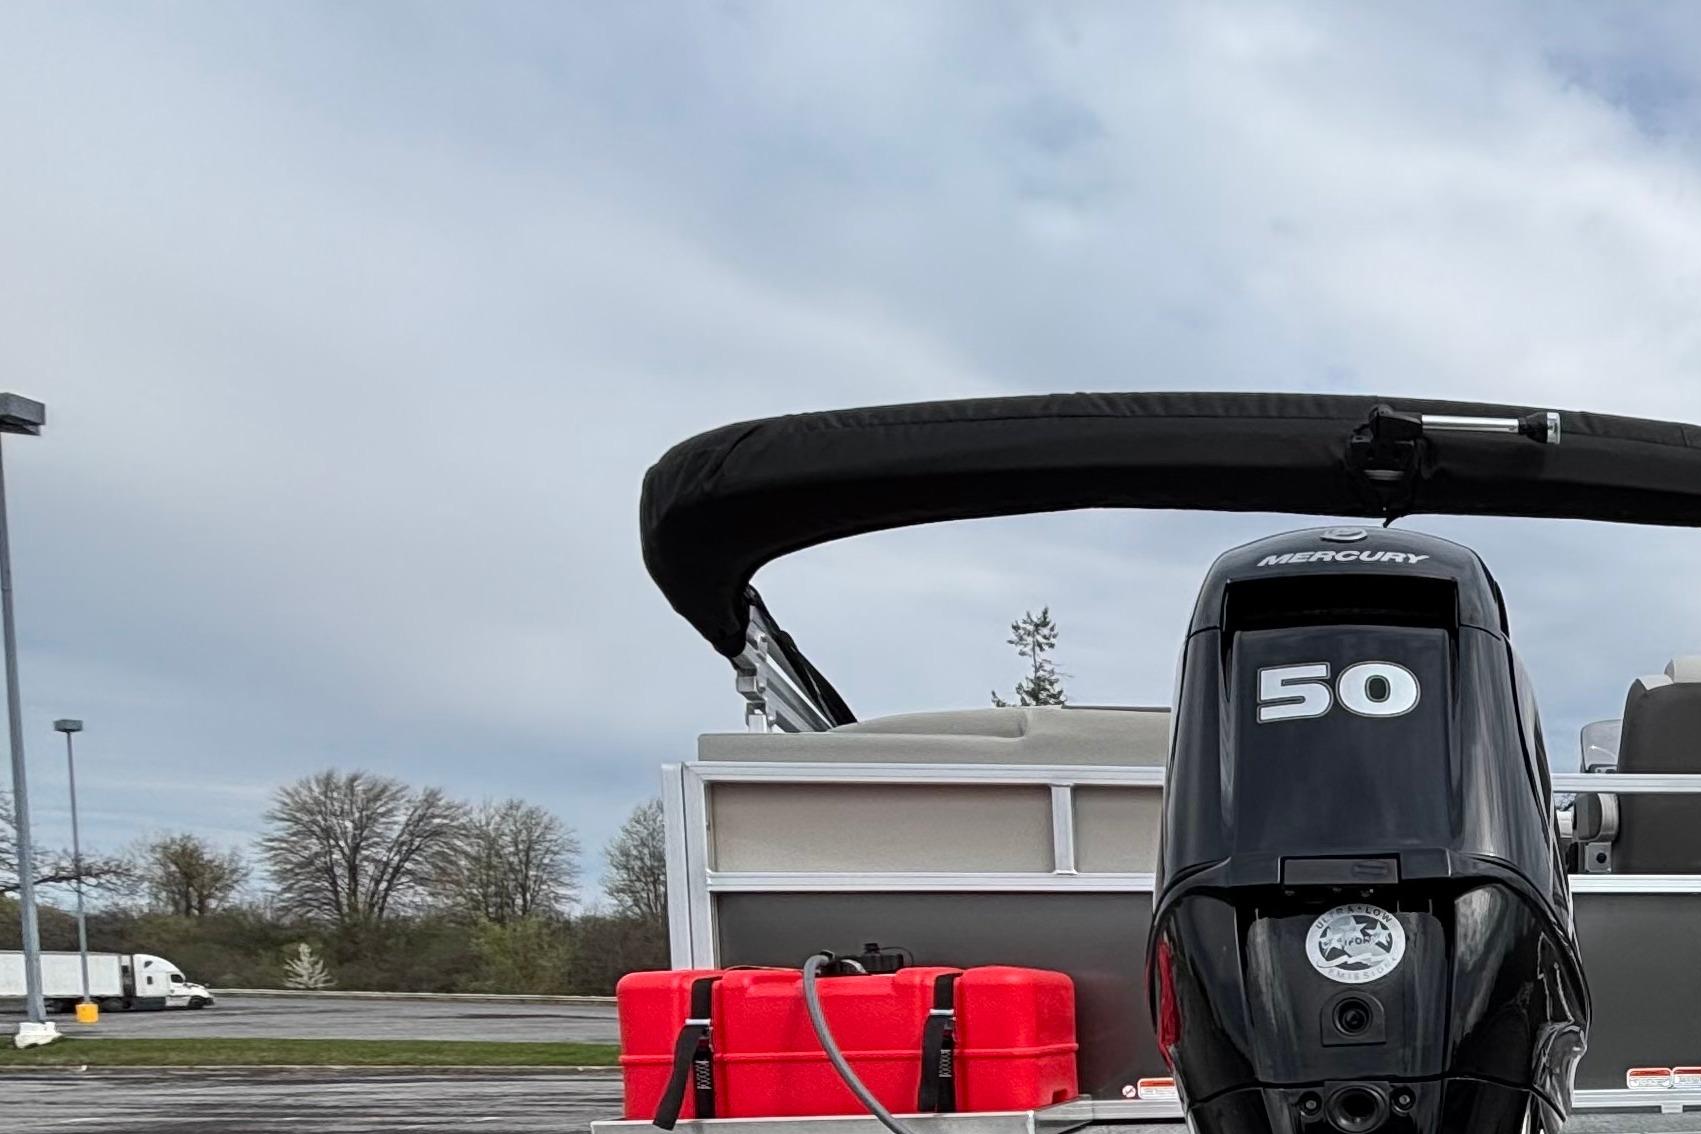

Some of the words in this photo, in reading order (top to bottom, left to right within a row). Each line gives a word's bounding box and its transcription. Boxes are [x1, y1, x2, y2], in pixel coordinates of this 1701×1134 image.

[1256, 550, 1430, 567] MERCURY
[1257, 660, 1421, 724] 50
[1366, 907, 1392, 923] LOW
